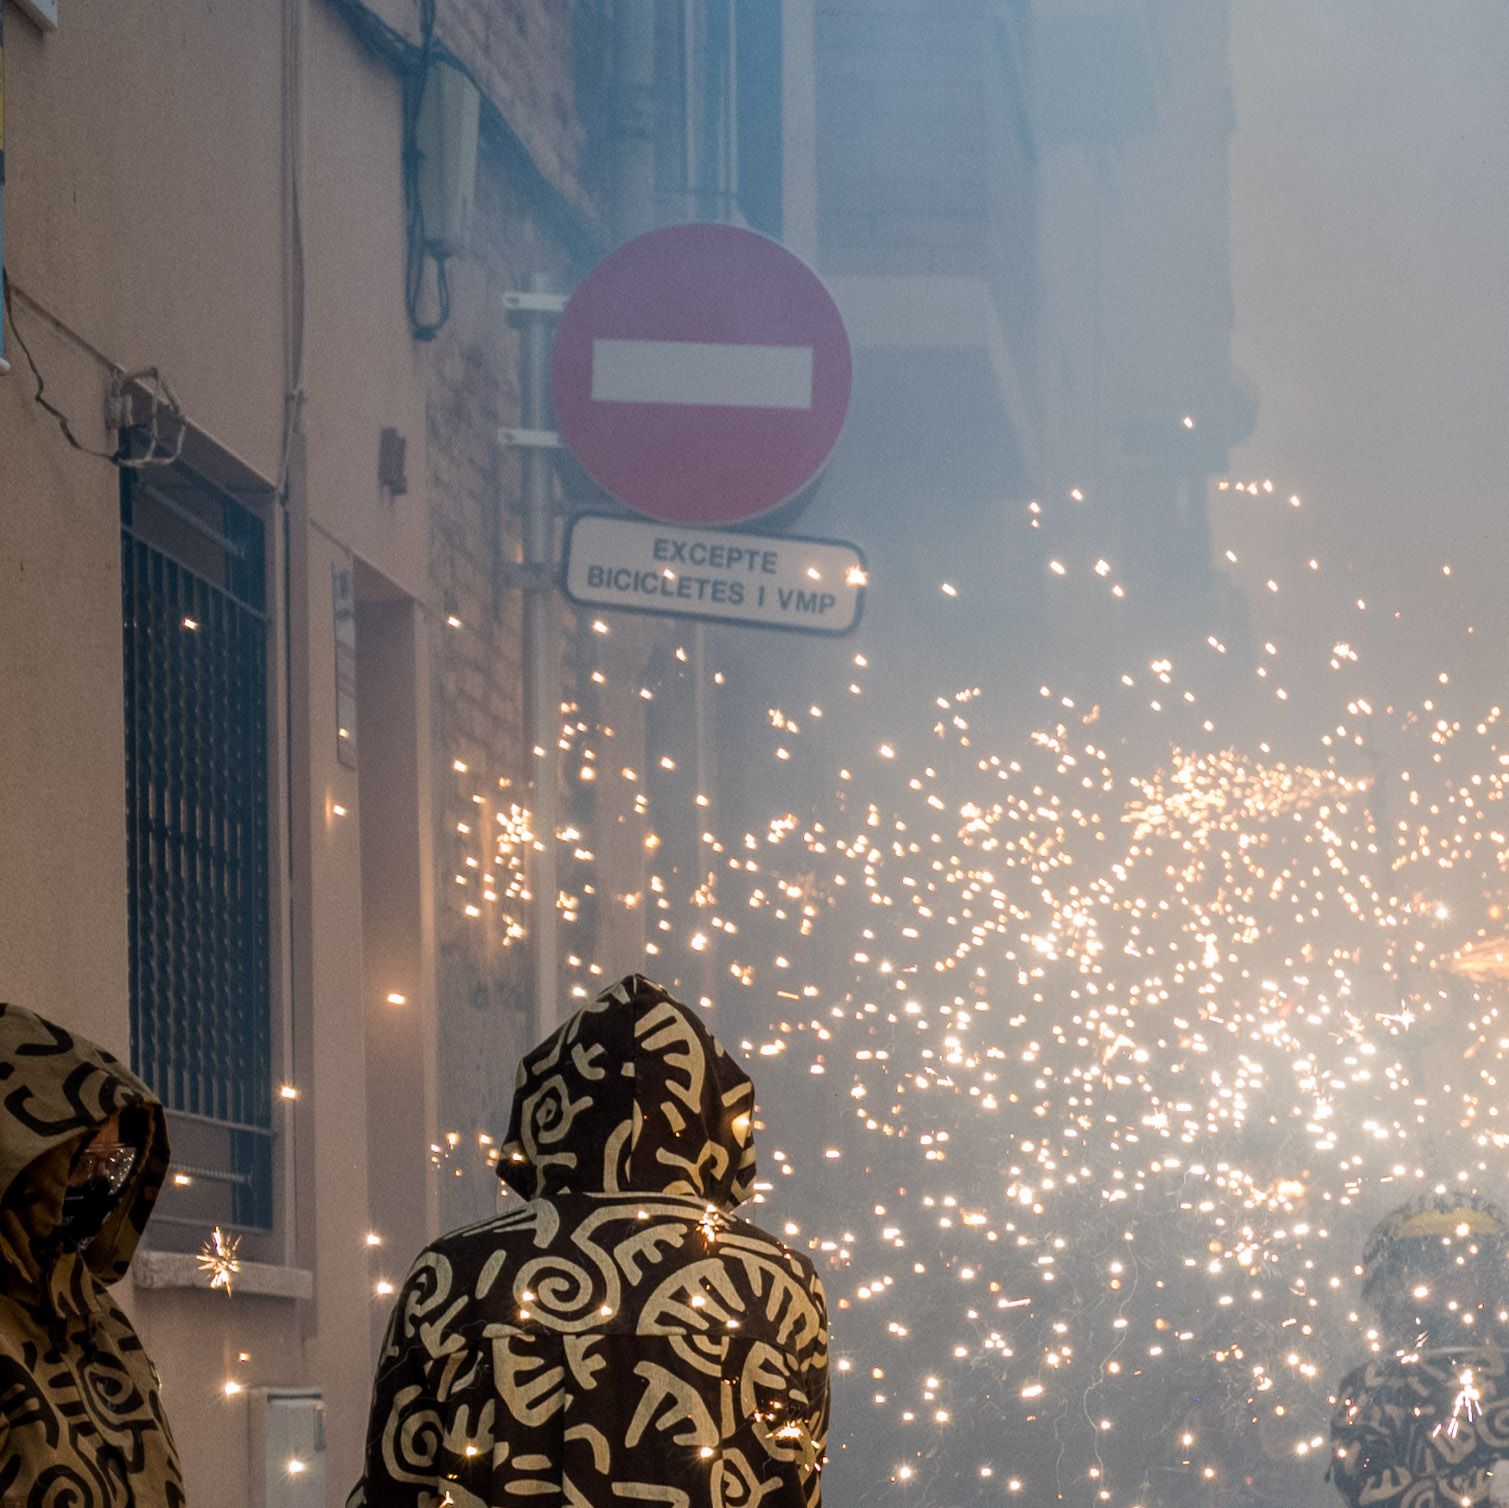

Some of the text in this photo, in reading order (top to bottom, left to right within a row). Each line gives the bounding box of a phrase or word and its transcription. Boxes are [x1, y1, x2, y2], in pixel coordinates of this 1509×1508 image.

[652, 537, 778, 575] EXCEPTE
[586, 564, 837, 616] BICICLETES I VMP
